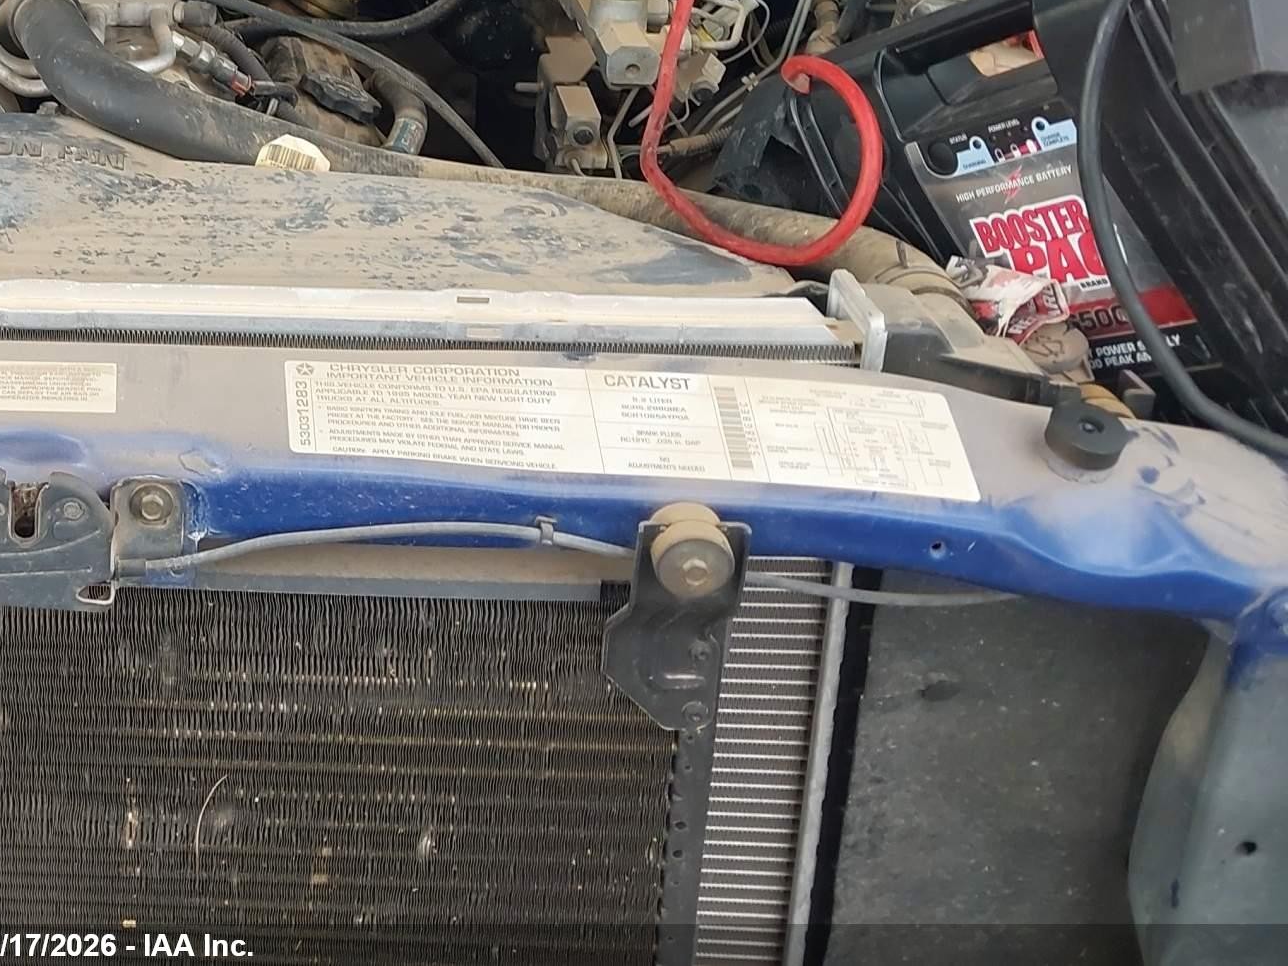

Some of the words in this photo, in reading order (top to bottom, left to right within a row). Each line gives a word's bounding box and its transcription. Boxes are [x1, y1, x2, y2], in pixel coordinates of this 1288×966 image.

[955, 190, 975, 203] HIGH
[976, 174, 1035, 198] PERFORMANCE
[1036, 164, 1073, 182] BATTERY
[974, 199, 1091, 253] BOOSTER
[1080, 279, 1108, 289] BRAND
[1097, 342, 1135, 356] POWER
[1105, 354, 1134, 367] PEAK
[330, 363, 408, 374] CHRYSLER
[413, 366, 520, 377] CORPORATION
[326, 372, 401, 381] IMPORTANT
[405, 374, 459, 384] VEHICLE
[462, 376, 553, 387] INFORMATION
[603, 374, 692, 390] CATALYST
[378, 382, 432, 391] CONFORMS
[470, 386, 489, 394] EPA
[492, 388, 557, 397] REGULATIONS
[448, 393, 472, 401] YEAR
[296, 380, 311, 446] 53031283
